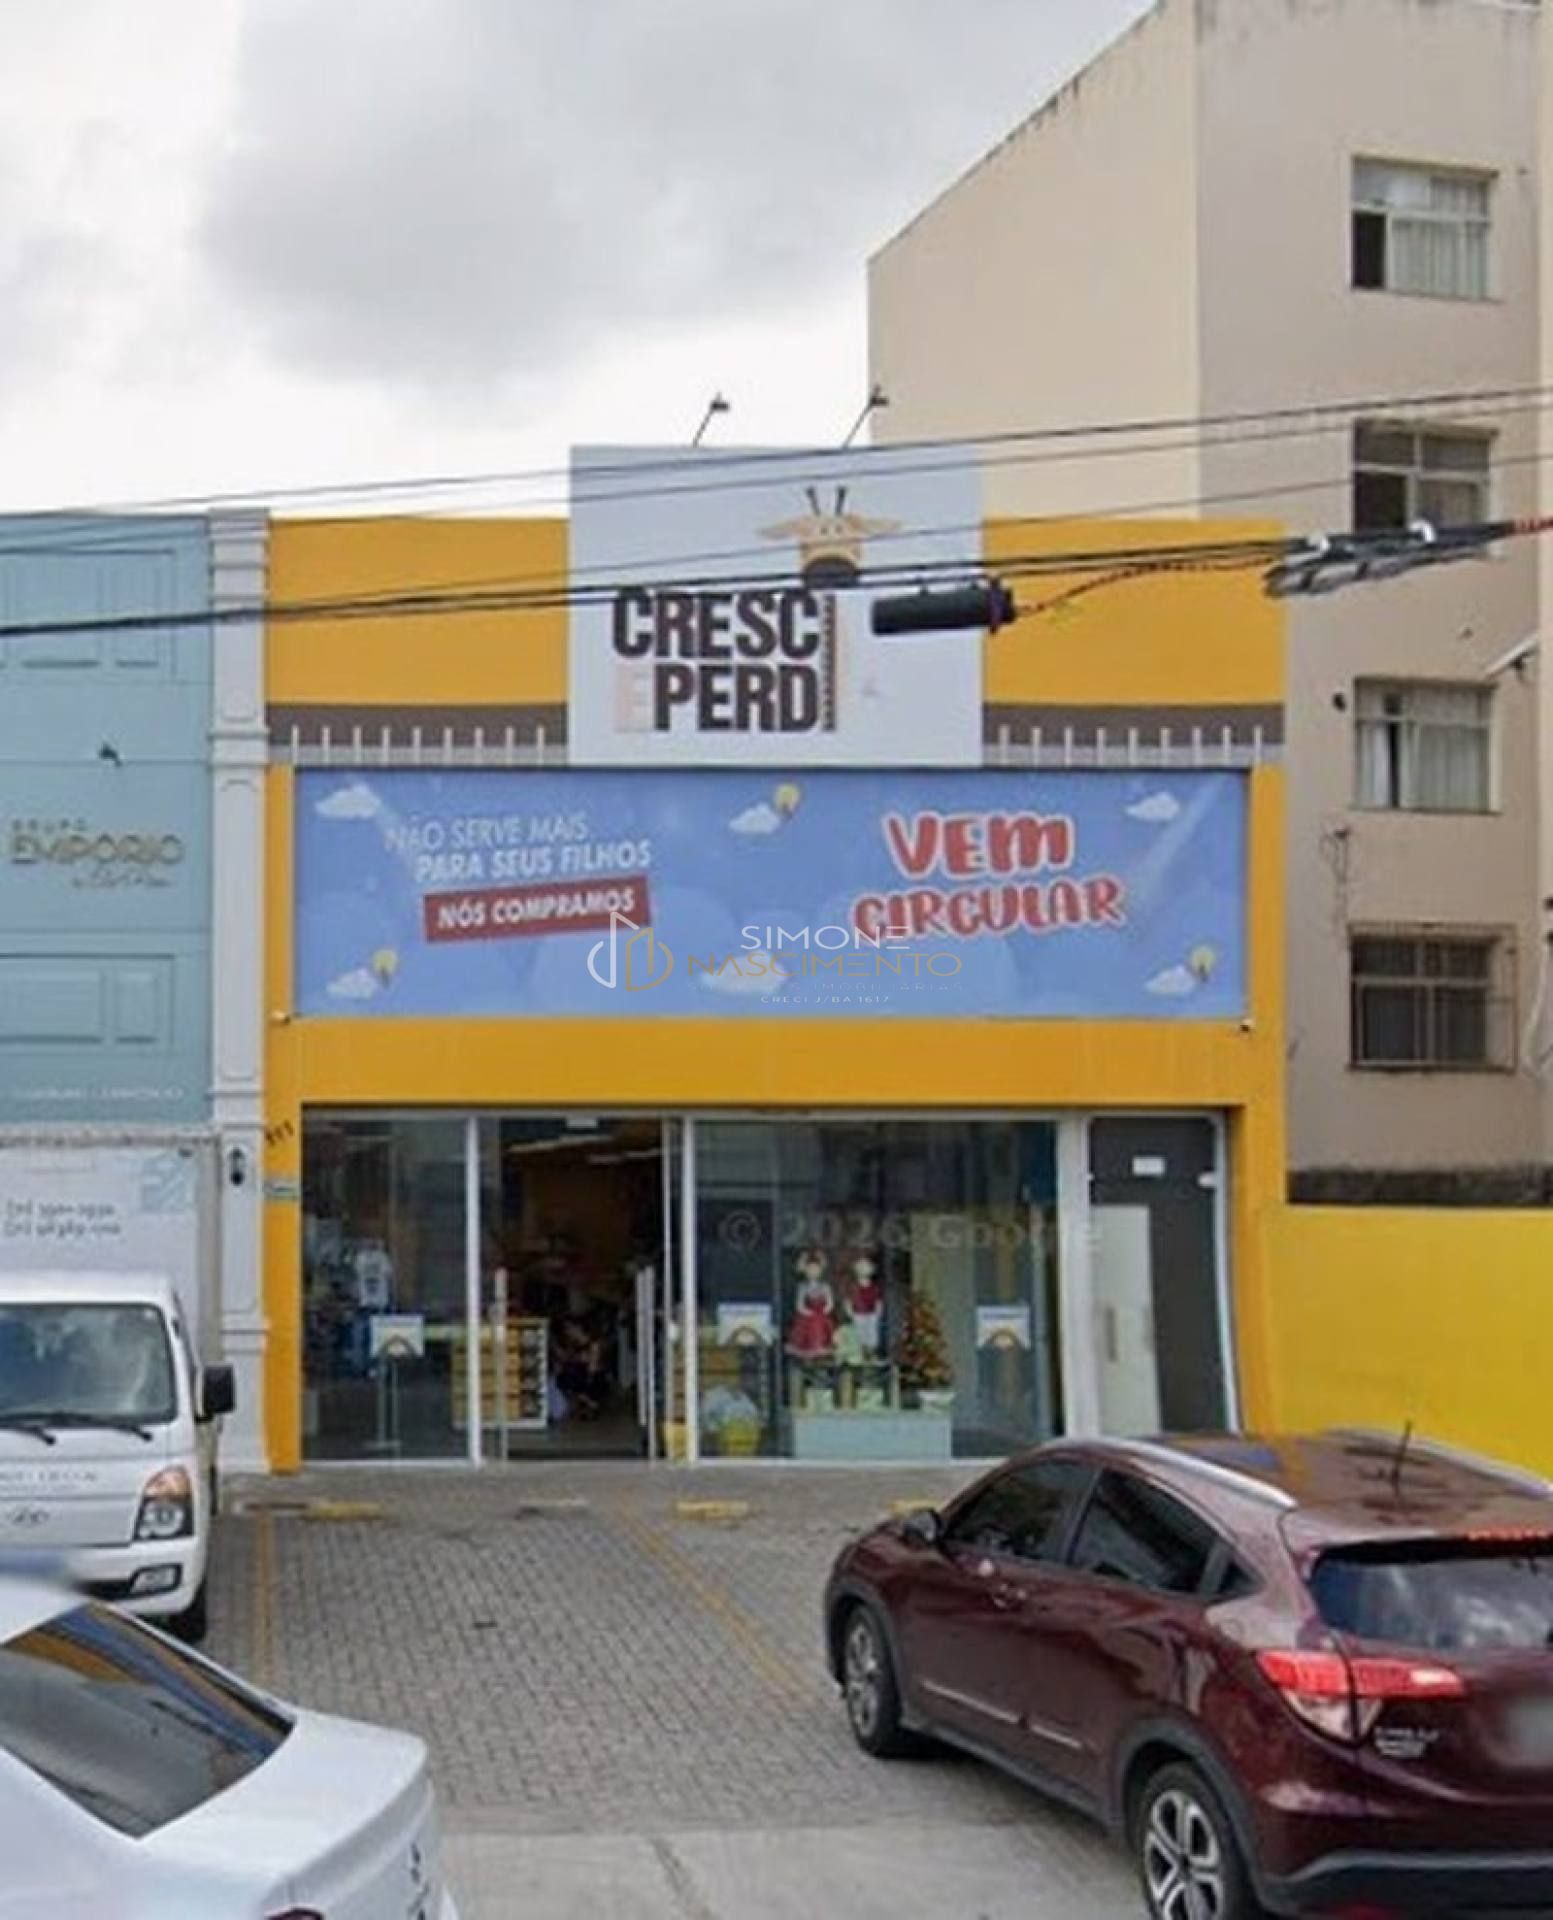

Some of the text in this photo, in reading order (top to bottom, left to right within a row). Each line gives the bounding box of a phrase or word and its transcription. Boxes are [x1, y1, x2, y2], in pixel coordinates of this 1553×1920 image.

[449, 817, 521, 850] SERVE
[527, 811, 589, 846] MAIS
[415, 840, 652, 883] PARA SEUS FILHOS
[437, 888, 635, 930] NÓS COMPRAMOS
[850, 872, 1127, 943] CIRCULAR
